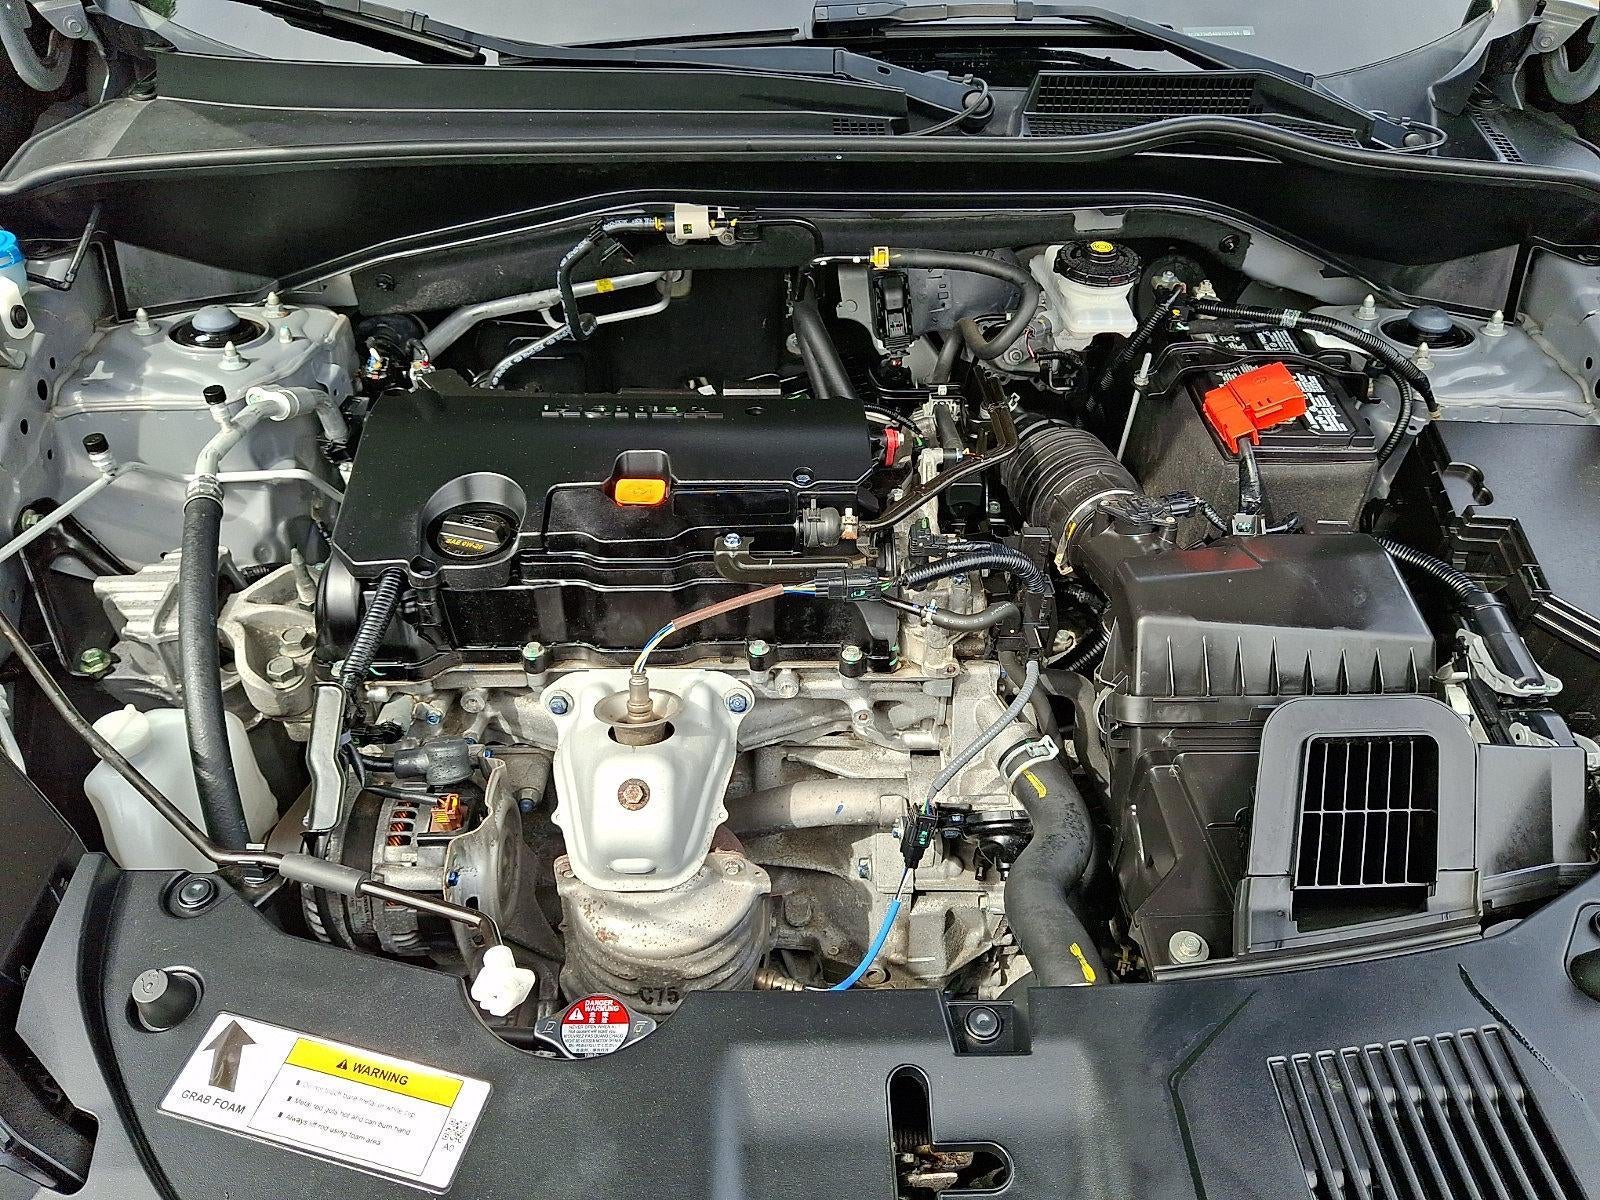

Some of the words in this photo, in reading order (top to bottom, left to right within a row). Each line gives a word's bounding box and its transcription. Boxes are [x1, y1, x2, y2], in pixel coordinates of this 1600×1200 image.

[352, 1062, 409, 1085] WARNING
[181, 1089, 212, 1105] GRAB
[212, 1097, 247, 1115] FOAM
